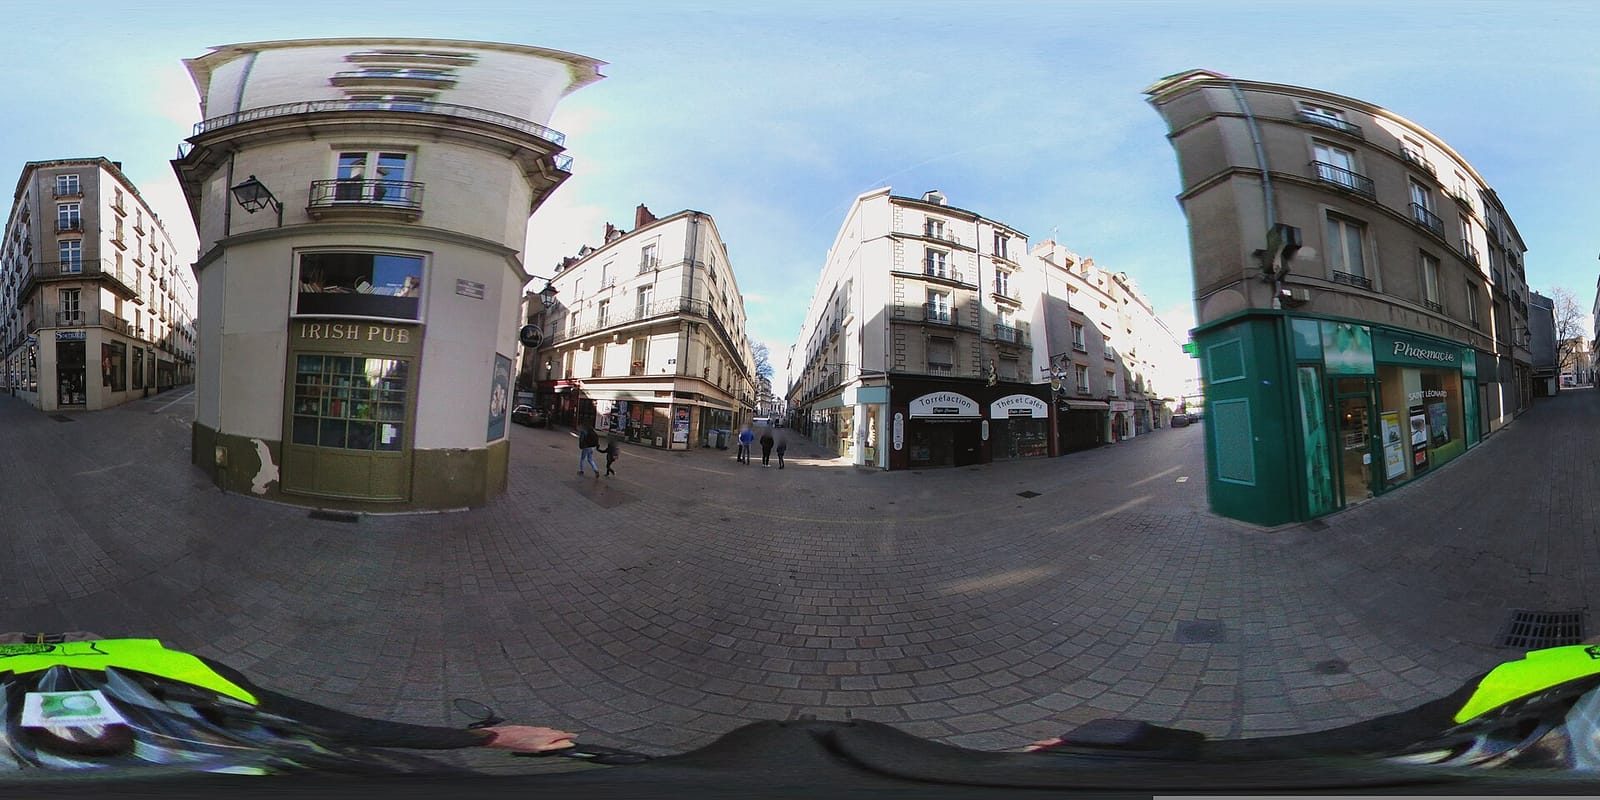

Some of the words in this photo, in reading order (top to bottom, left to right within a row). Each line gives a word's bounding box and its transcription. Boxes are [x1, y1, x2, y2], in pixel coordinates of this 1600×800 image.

[300, 323, 360, 340] IRISH
[367, 326, 410, 343] PUB
[1393, 341, 1455, 361] Pharmacie
[919, 394, 971, 409] Torréfaction
[996, 399, 1014, 408] Thés
[1024, 397, 1043, 409] Cafés
[1408, 391, 1424, 401] SAINT
